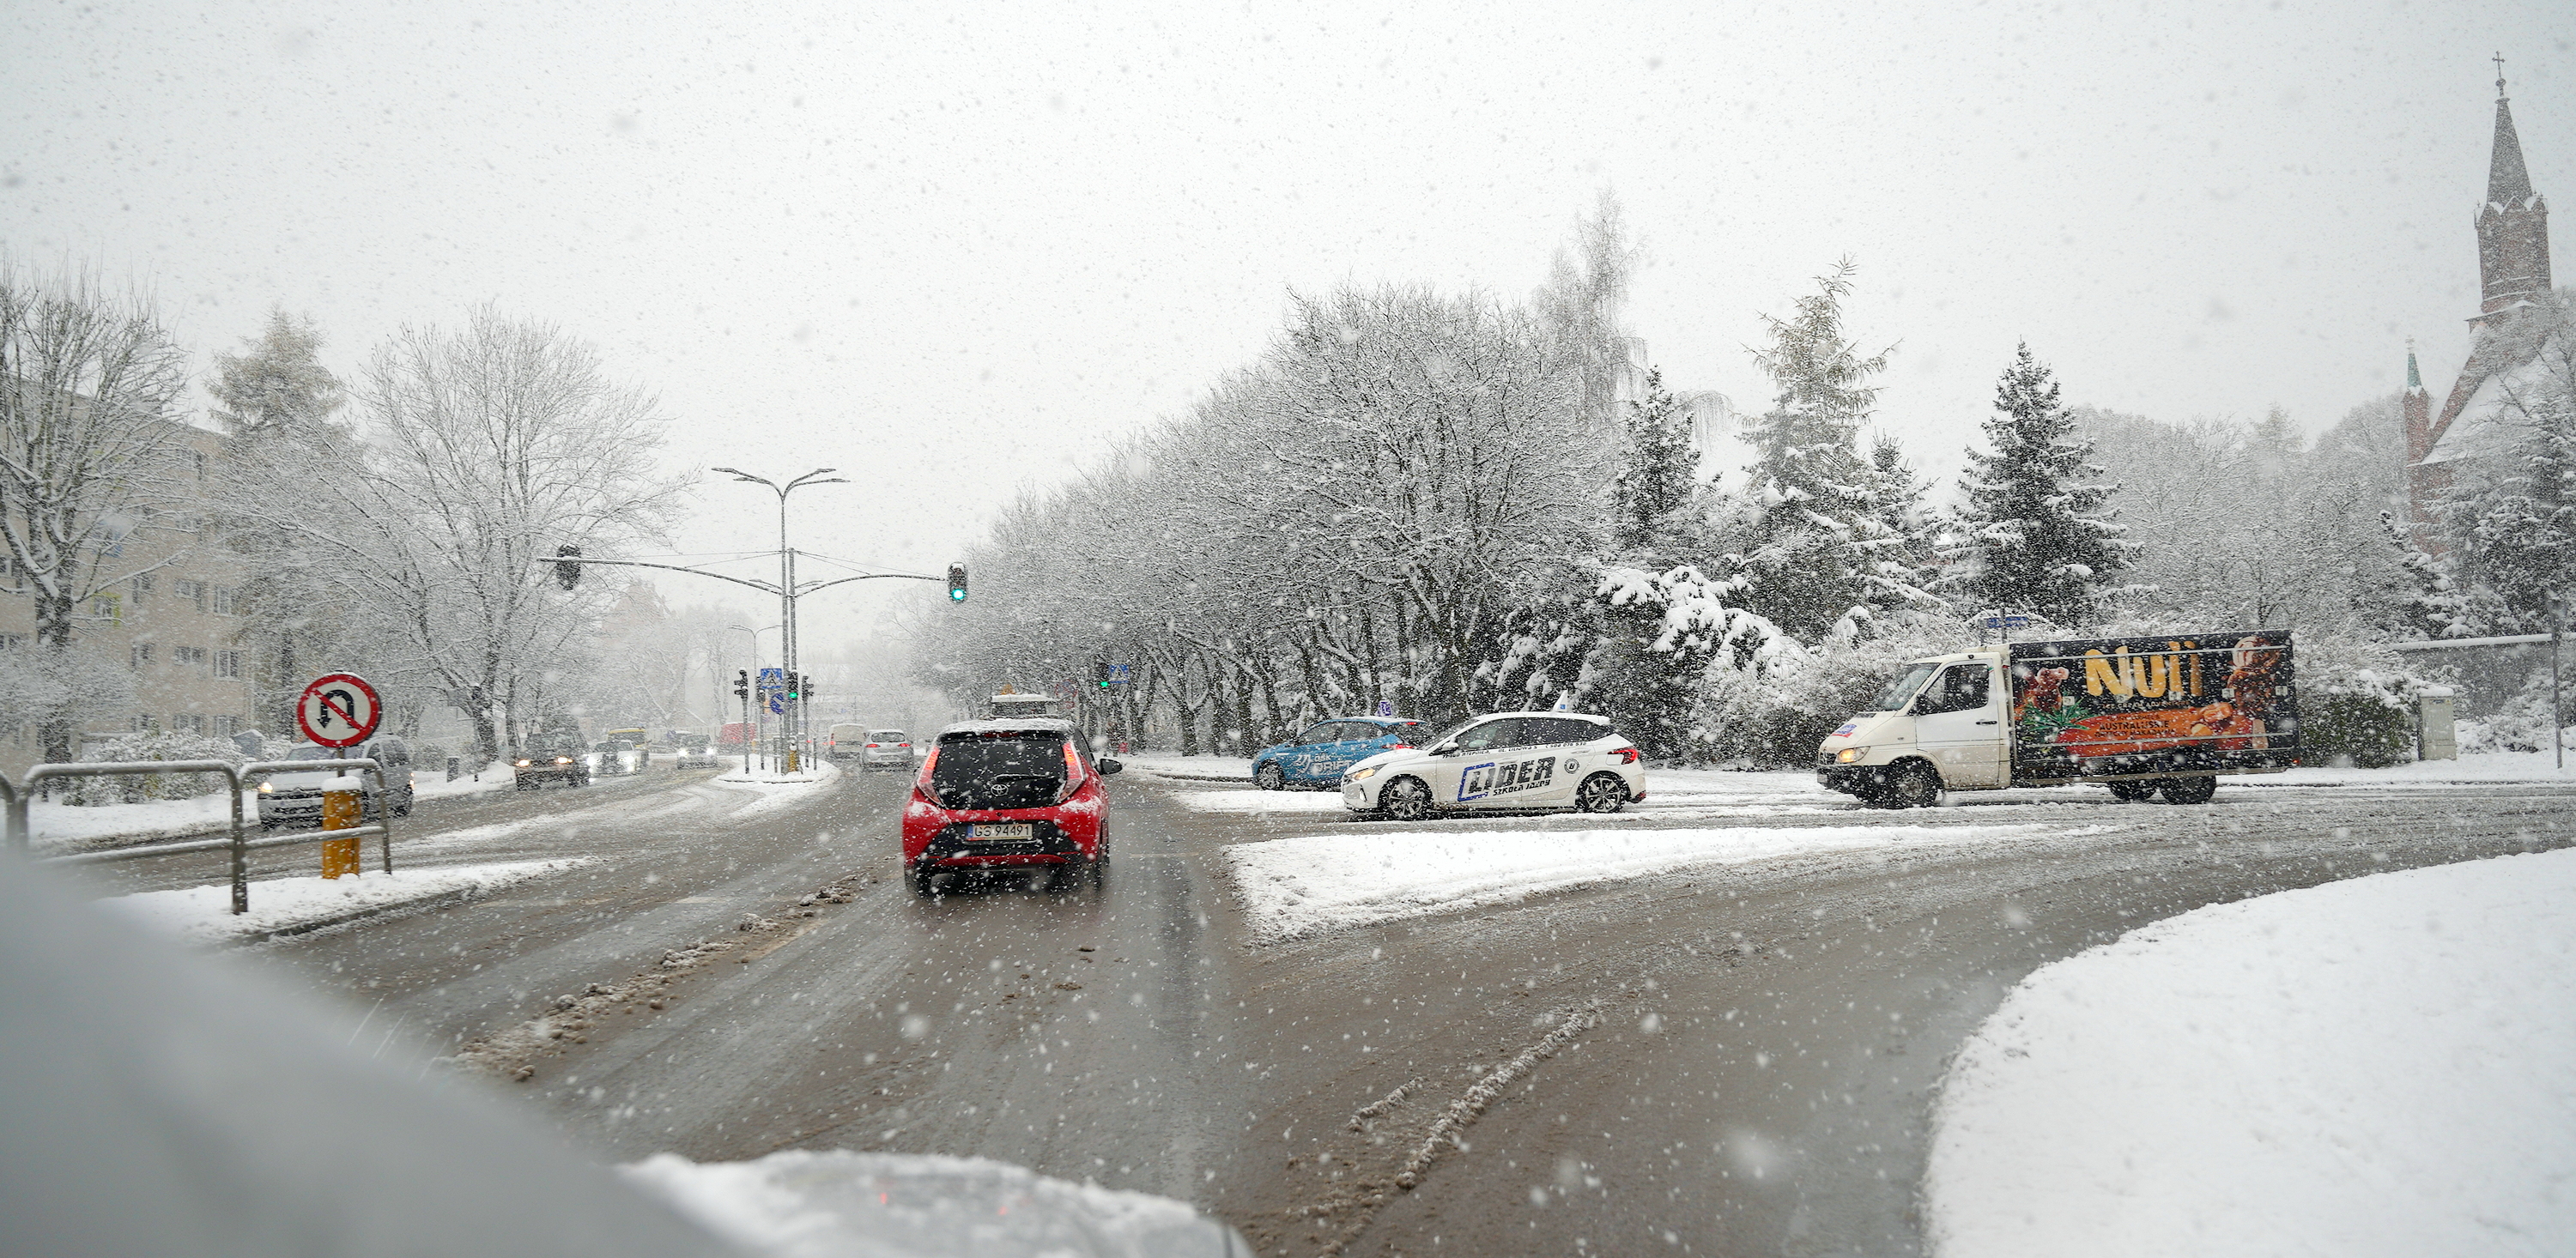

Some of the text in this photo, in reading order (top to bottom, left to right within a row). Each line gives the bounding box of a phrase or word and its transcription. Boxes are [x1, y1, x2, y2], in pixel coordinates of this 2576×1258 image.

[1469, 756, 1555, 794] LIDER
[1525, 779, 1551, 790] JAZDY
[974, 826, 991, 837] GS
[995, 825, 1029, 836] 94491
